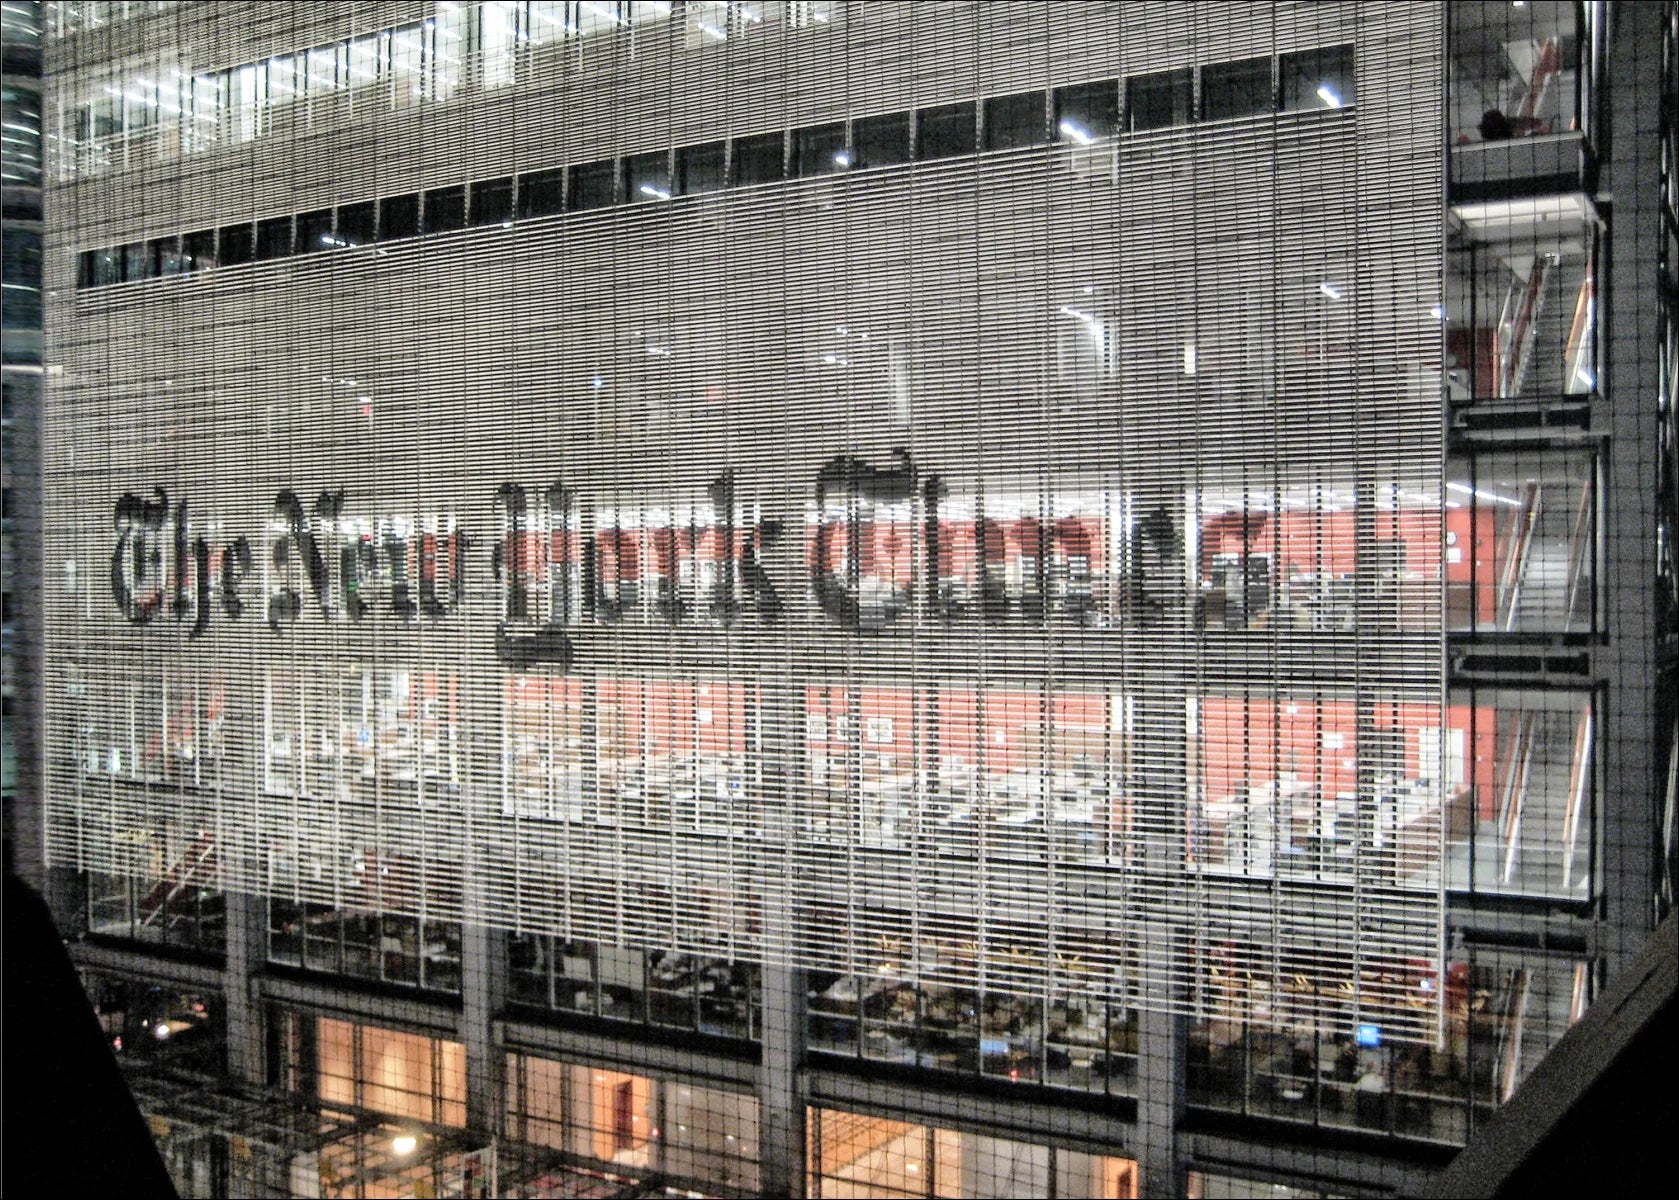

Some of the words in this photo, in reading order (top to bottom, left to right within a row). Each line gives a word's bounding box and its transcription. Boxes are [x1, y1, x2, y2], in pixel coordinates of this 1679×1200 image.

[111, 484, 253, 638] The
[268, 485, 466, 637] New
[494, 468, 786, 674] York
[811, 447, 1270, 633] Times
